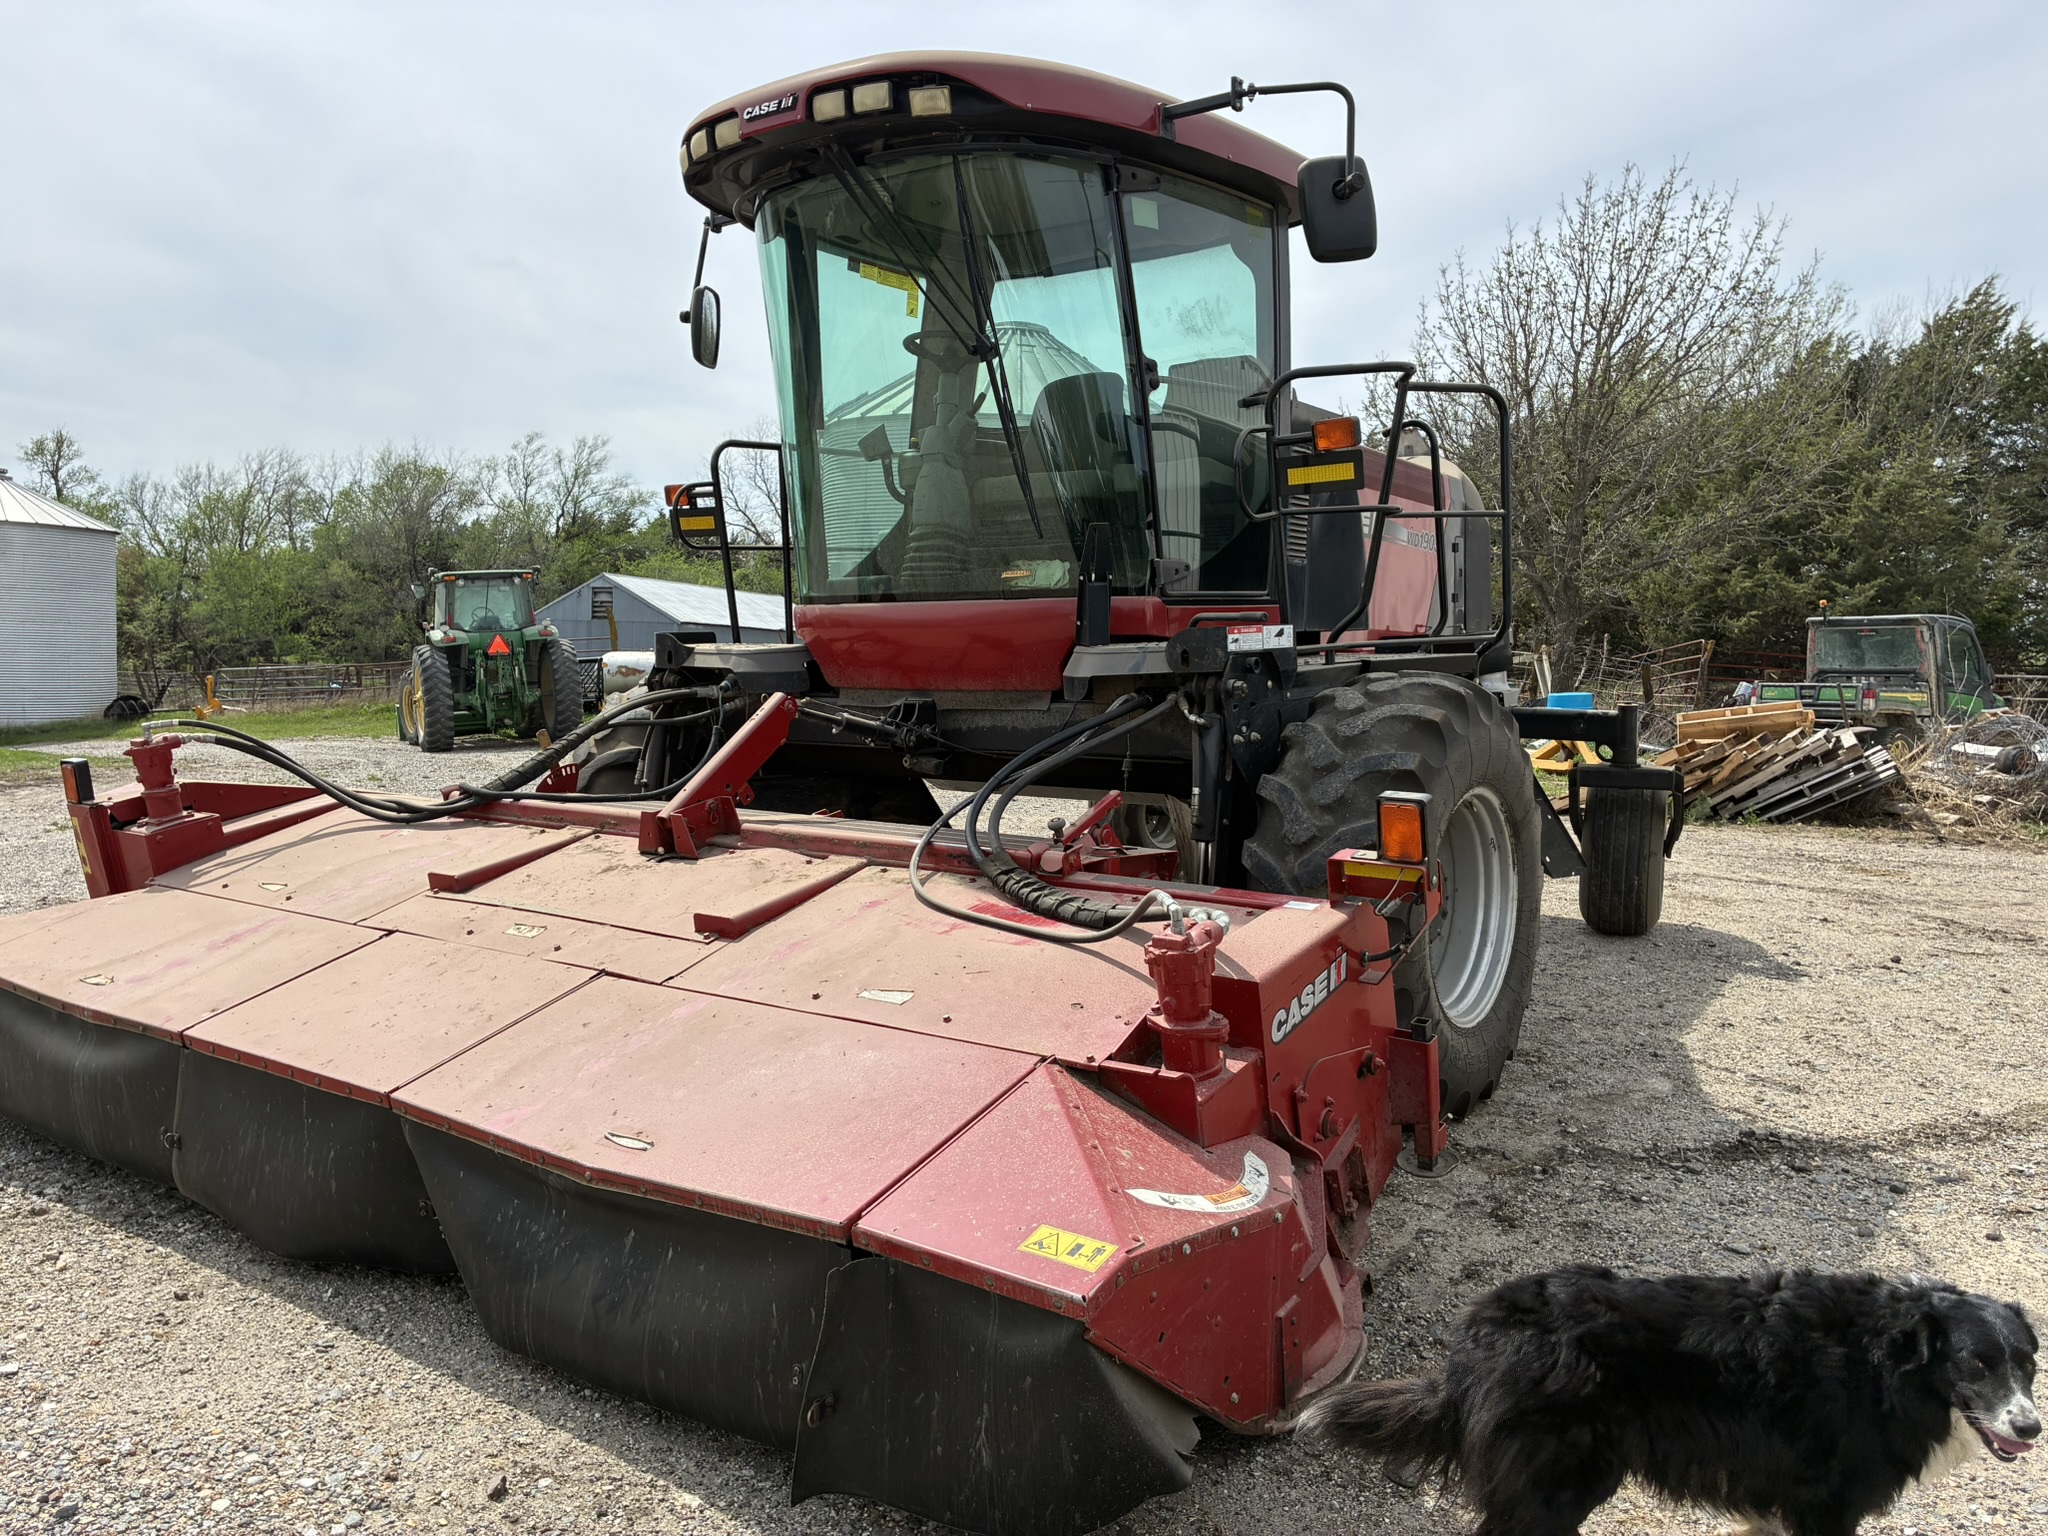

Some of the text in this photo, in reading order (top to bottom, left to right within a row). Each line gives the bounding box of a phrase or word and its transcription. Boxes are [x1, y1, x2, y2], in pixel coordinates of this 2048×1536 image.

[743, 100, 779, 120] CASE
[1407, 530, 1437, 551] WD190
[1271, 969, 1329, 1044] CASE
